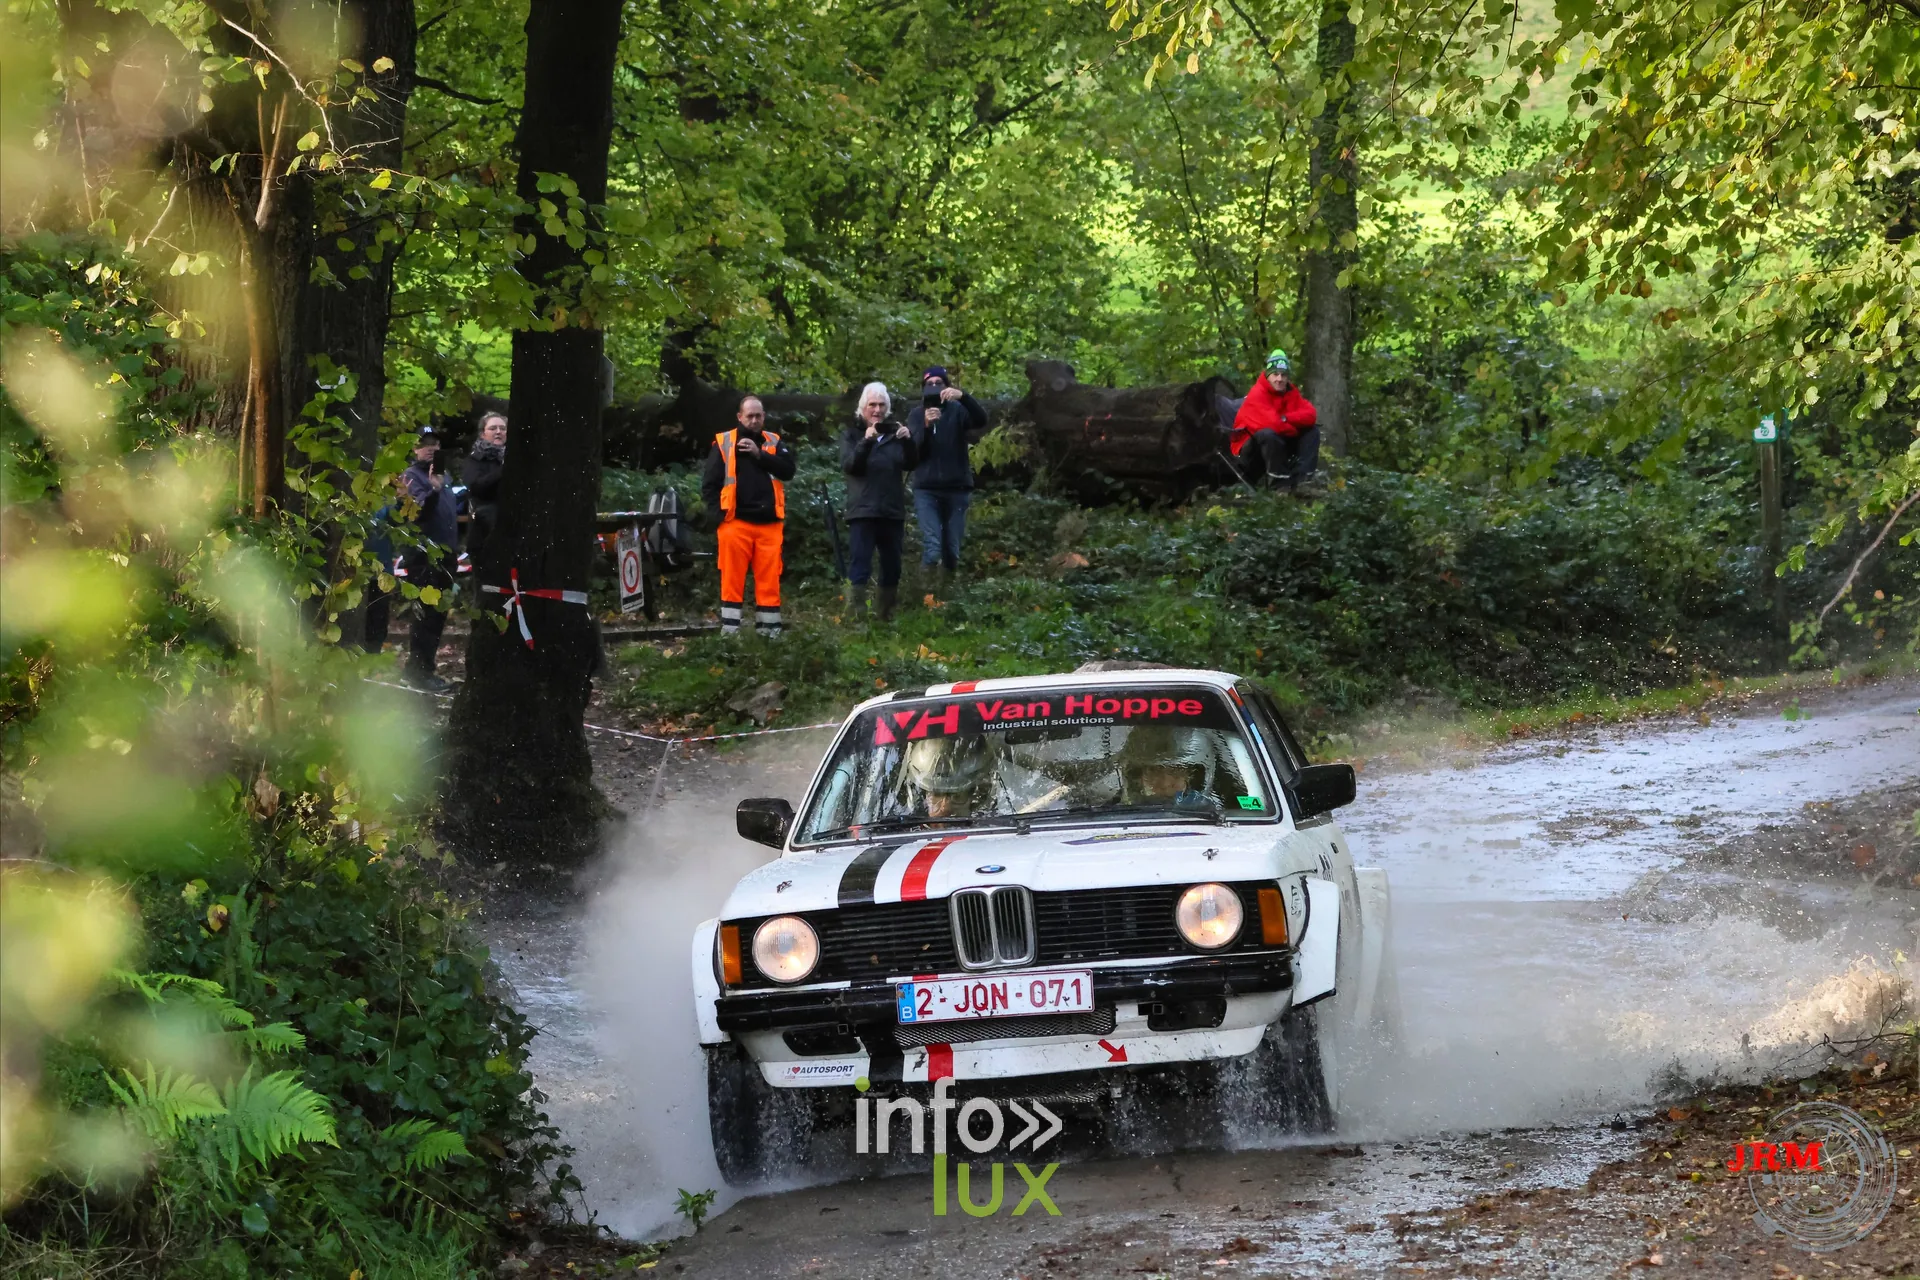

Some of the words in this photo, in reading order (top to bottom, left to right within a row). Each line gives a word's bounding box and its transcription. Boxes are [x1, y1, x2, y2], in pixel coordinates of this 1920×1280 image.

[976, 699, 1051, 721] Van
[1065, 694, 1203, 719] Hoppe
[983, 719, 1048, 731] Industrial
[1051, 716, 1114, 726] solutions
[1251, 798, 1262, 809] 4
[902, 1006, 913, 1019] B
[800, 1065, 855, 1074] AUTOSPORT
